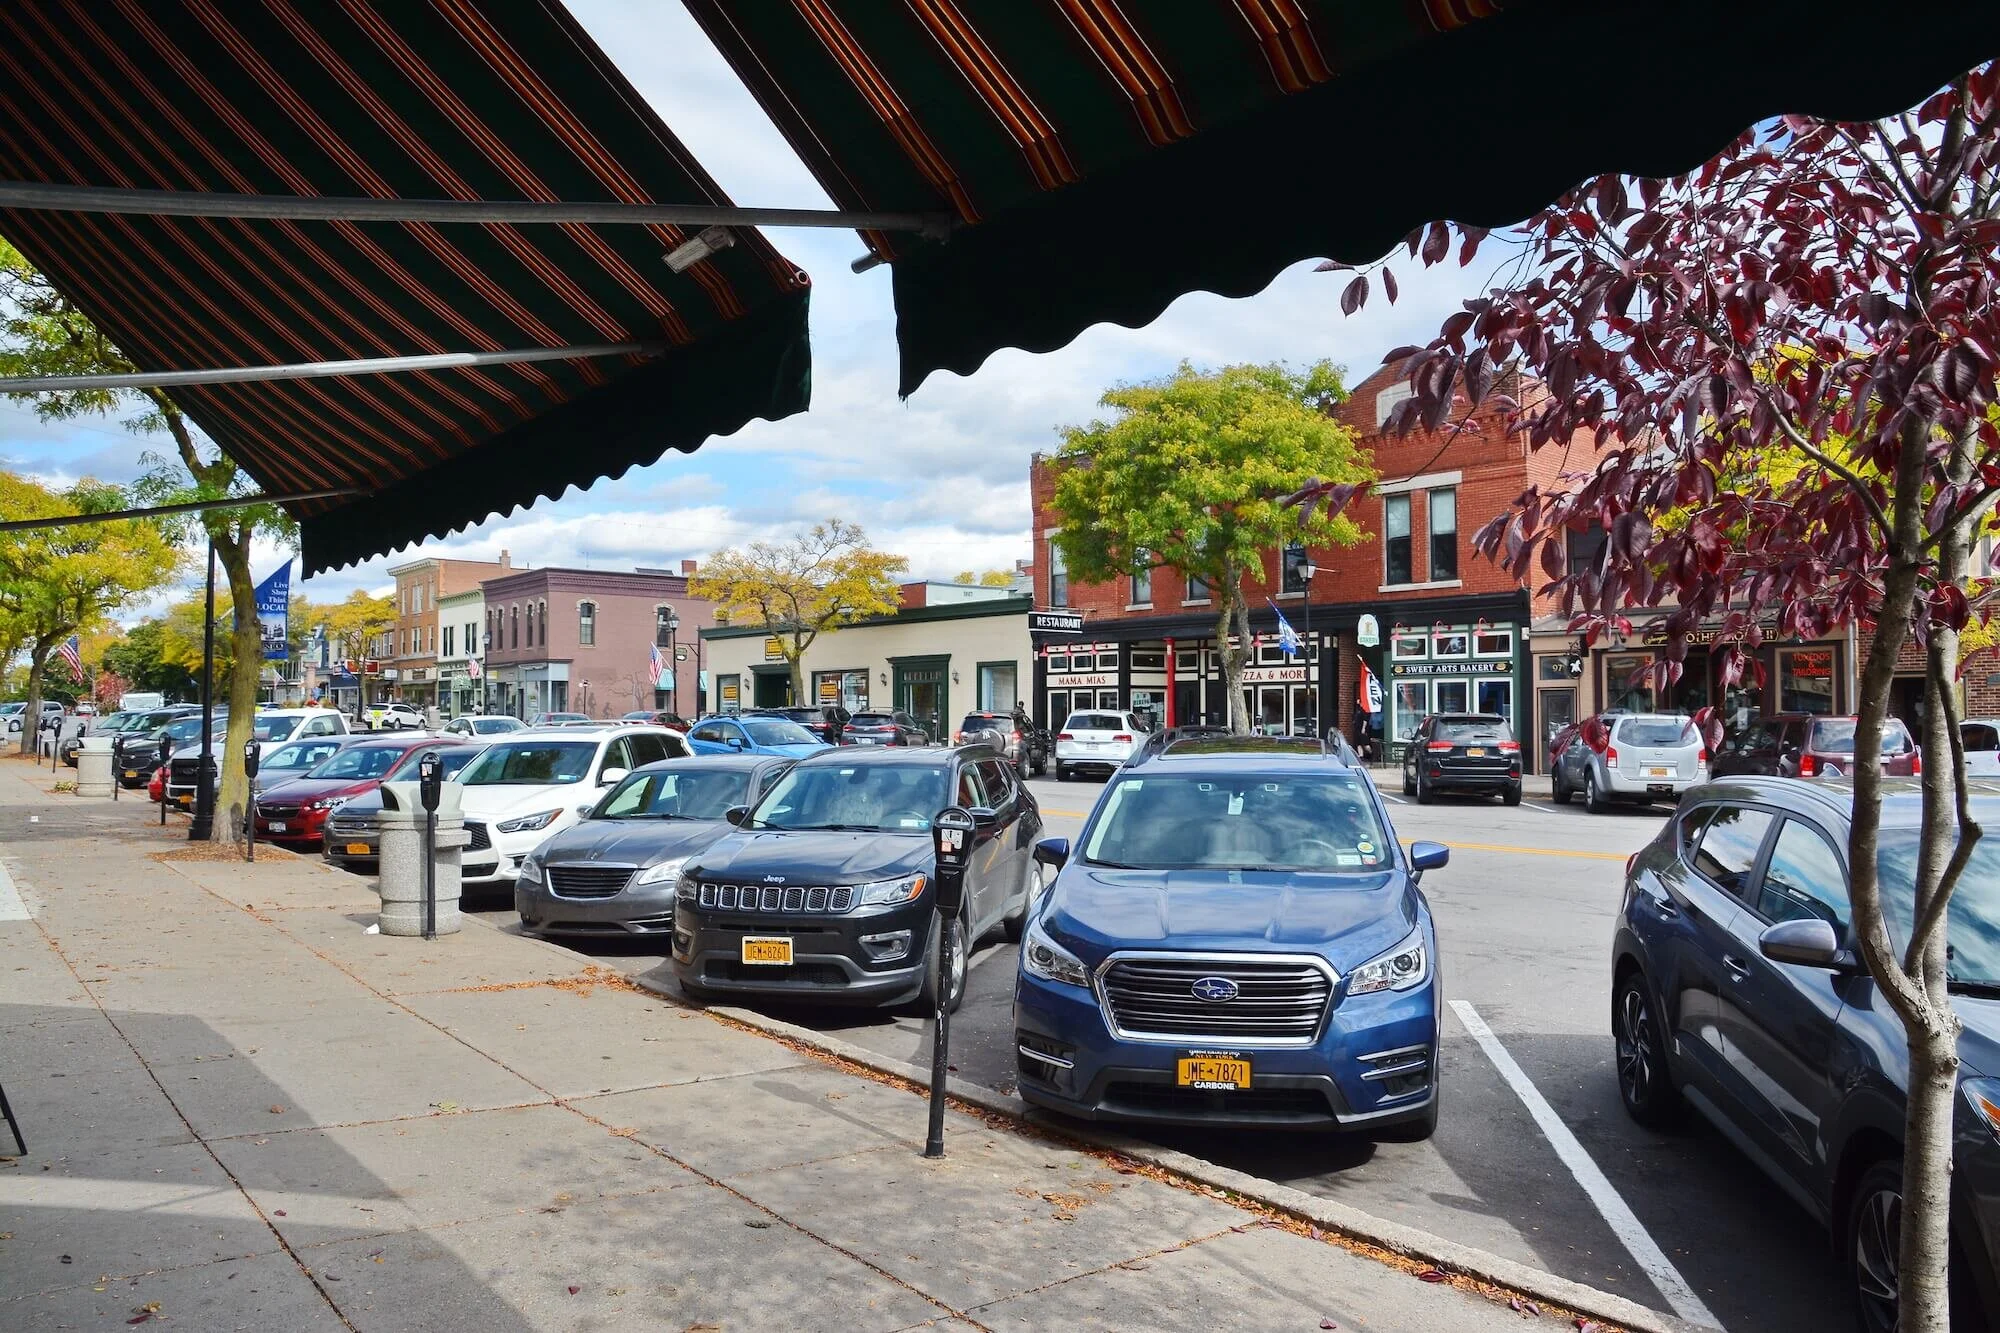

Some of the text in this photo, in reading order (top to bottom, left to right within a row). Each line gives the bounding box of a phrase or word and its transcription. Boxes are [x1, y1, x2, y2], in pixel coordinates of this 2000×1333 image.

[271, 590, 287, 598] Shop
[256, 603, 287, 612] LOCAL
[1036, 616, 1081, 629] RESTAURANT
[1406, 663, 1495, 674] SWEET ARTS BAKERY
[1551, 664, 1563, 672] 97
[1268, 670, 1275, 680] &
[1058, 676, 1106, 685] MAMA MIAS
[763, 874, 786, 883] Jeep
[1194, 1081, 1235, 1090] CARBONE
